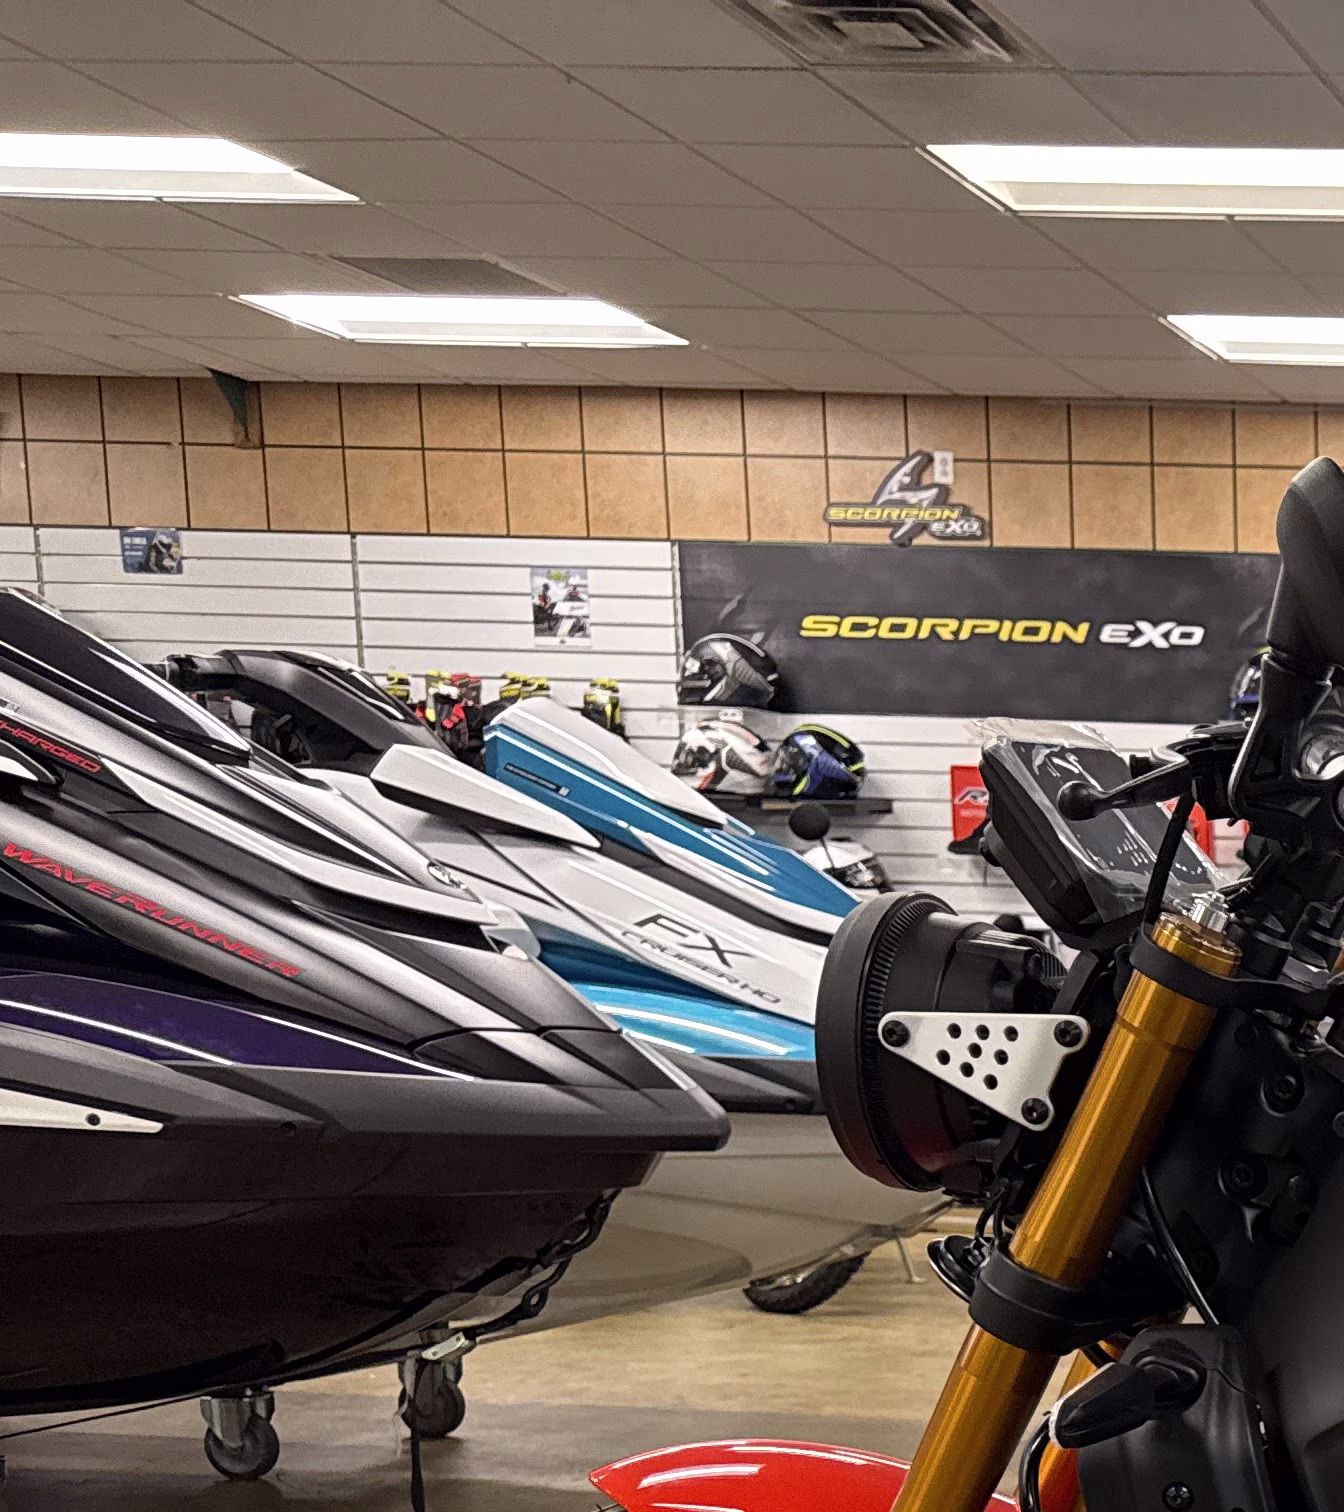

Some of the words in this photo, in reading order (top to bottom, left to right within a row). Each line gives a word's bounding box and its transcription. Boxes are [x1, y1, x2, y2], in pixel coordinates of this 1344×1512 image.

[827, 506, 962, 521] SCORPION
[799, 614, 1091, 645] SCORPION
[1099, 619, 1206, 649] EXO
[4, 841, 301, 977] WAVERUNNER
[633, 913, 757, 968] FX
